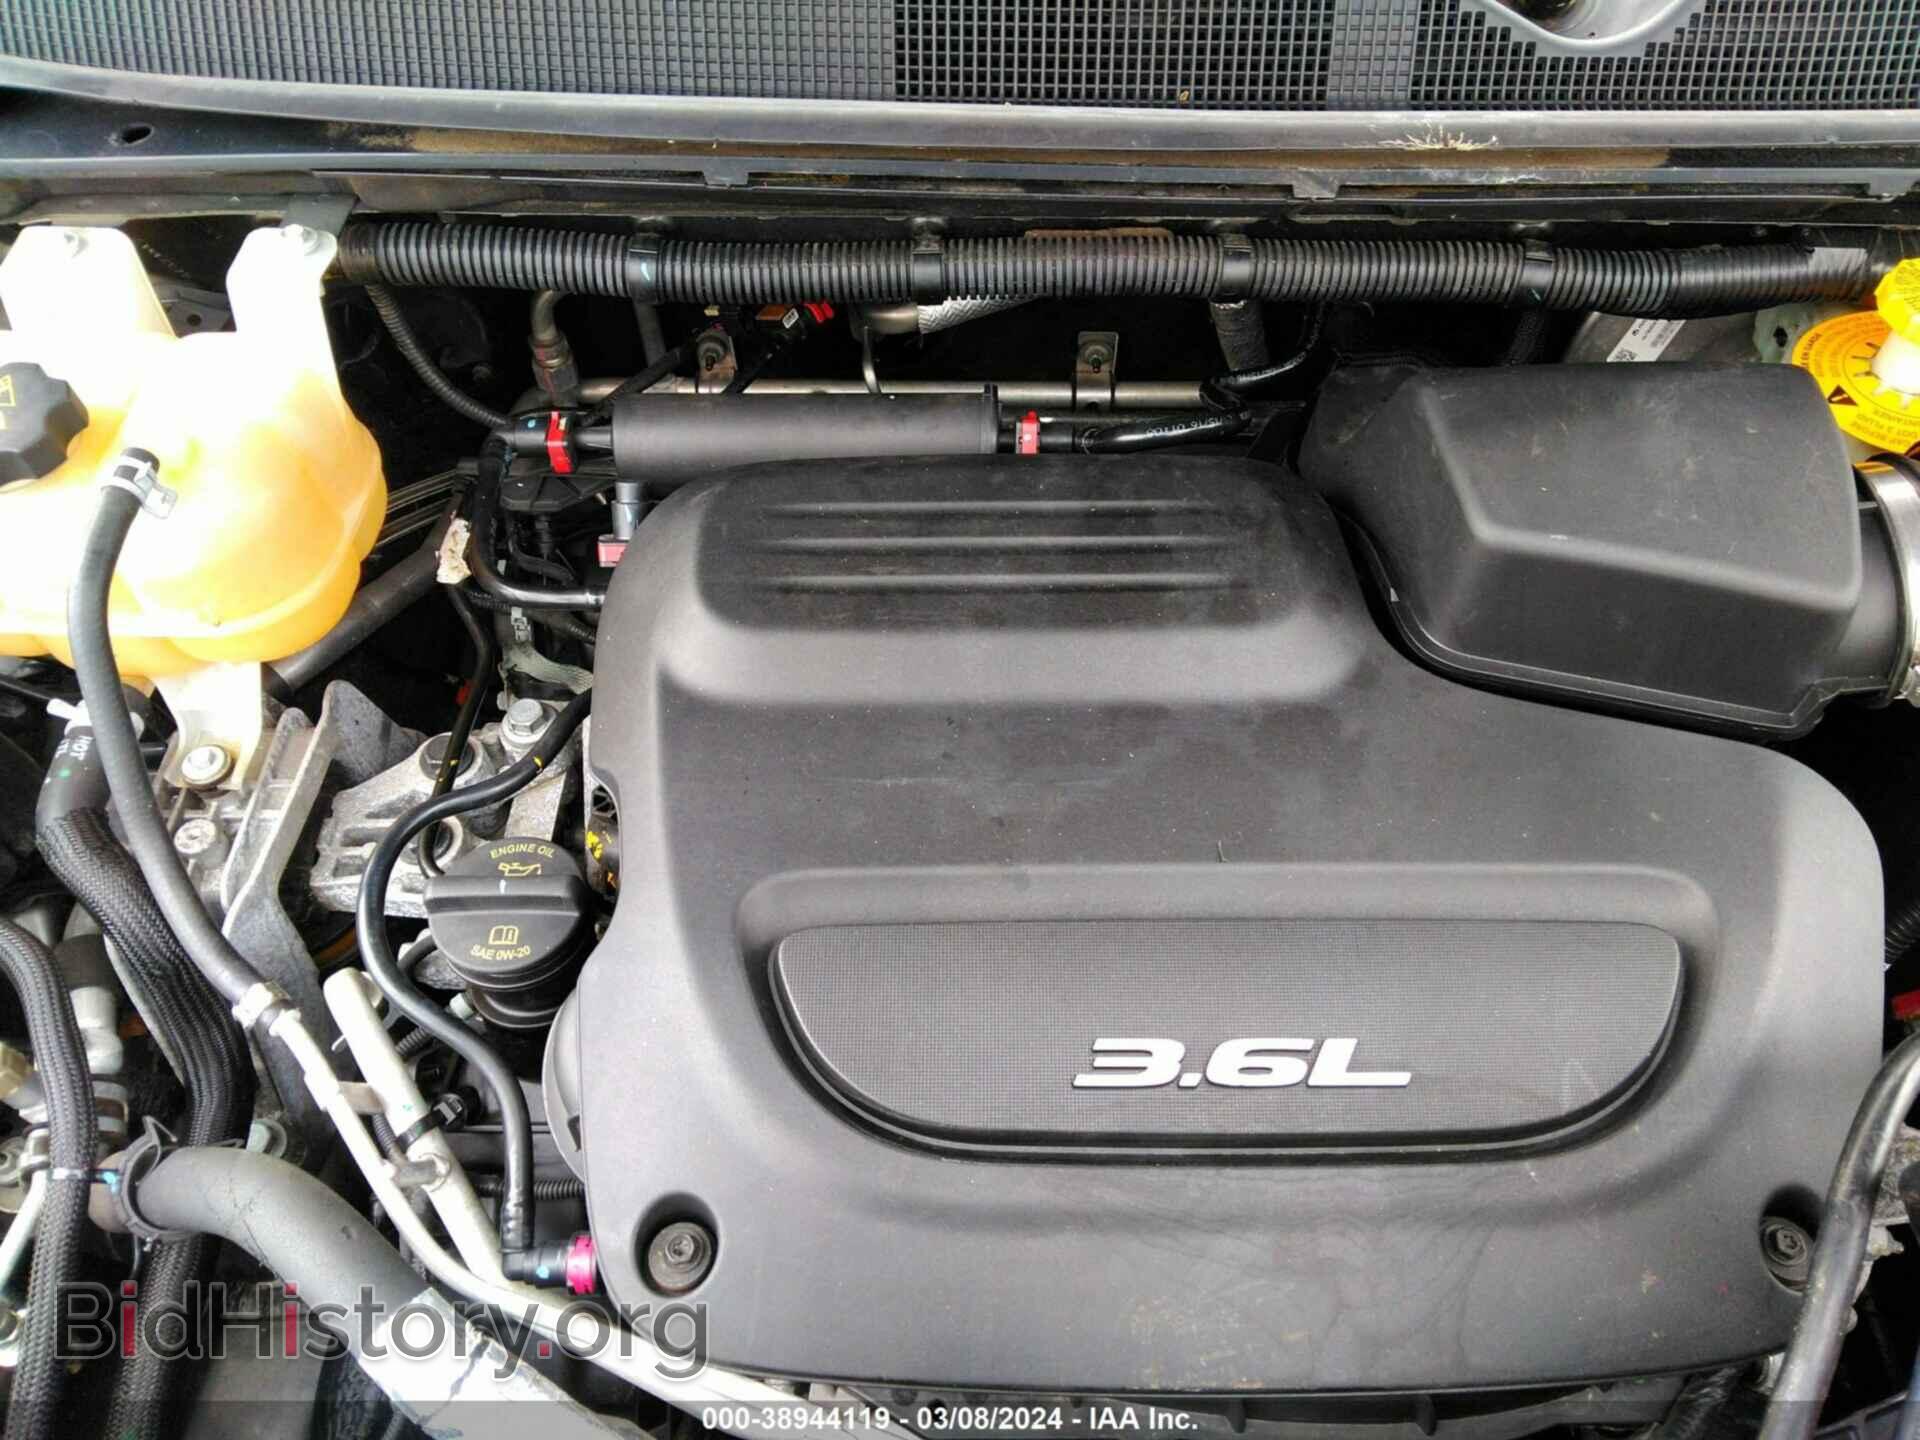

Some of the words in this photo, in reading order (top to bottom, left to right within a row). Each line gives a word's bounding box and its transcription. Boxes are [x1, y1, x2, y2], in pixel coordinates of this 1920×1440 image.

[489, 843, 536, 859] ENGINE
[538, 845, 555, 859] OIL
[470, 944, 495, 960] SAE
[495, 945, 531, 961] 0W-20
[1072, 1038, 1412, 1088] 3.6L
